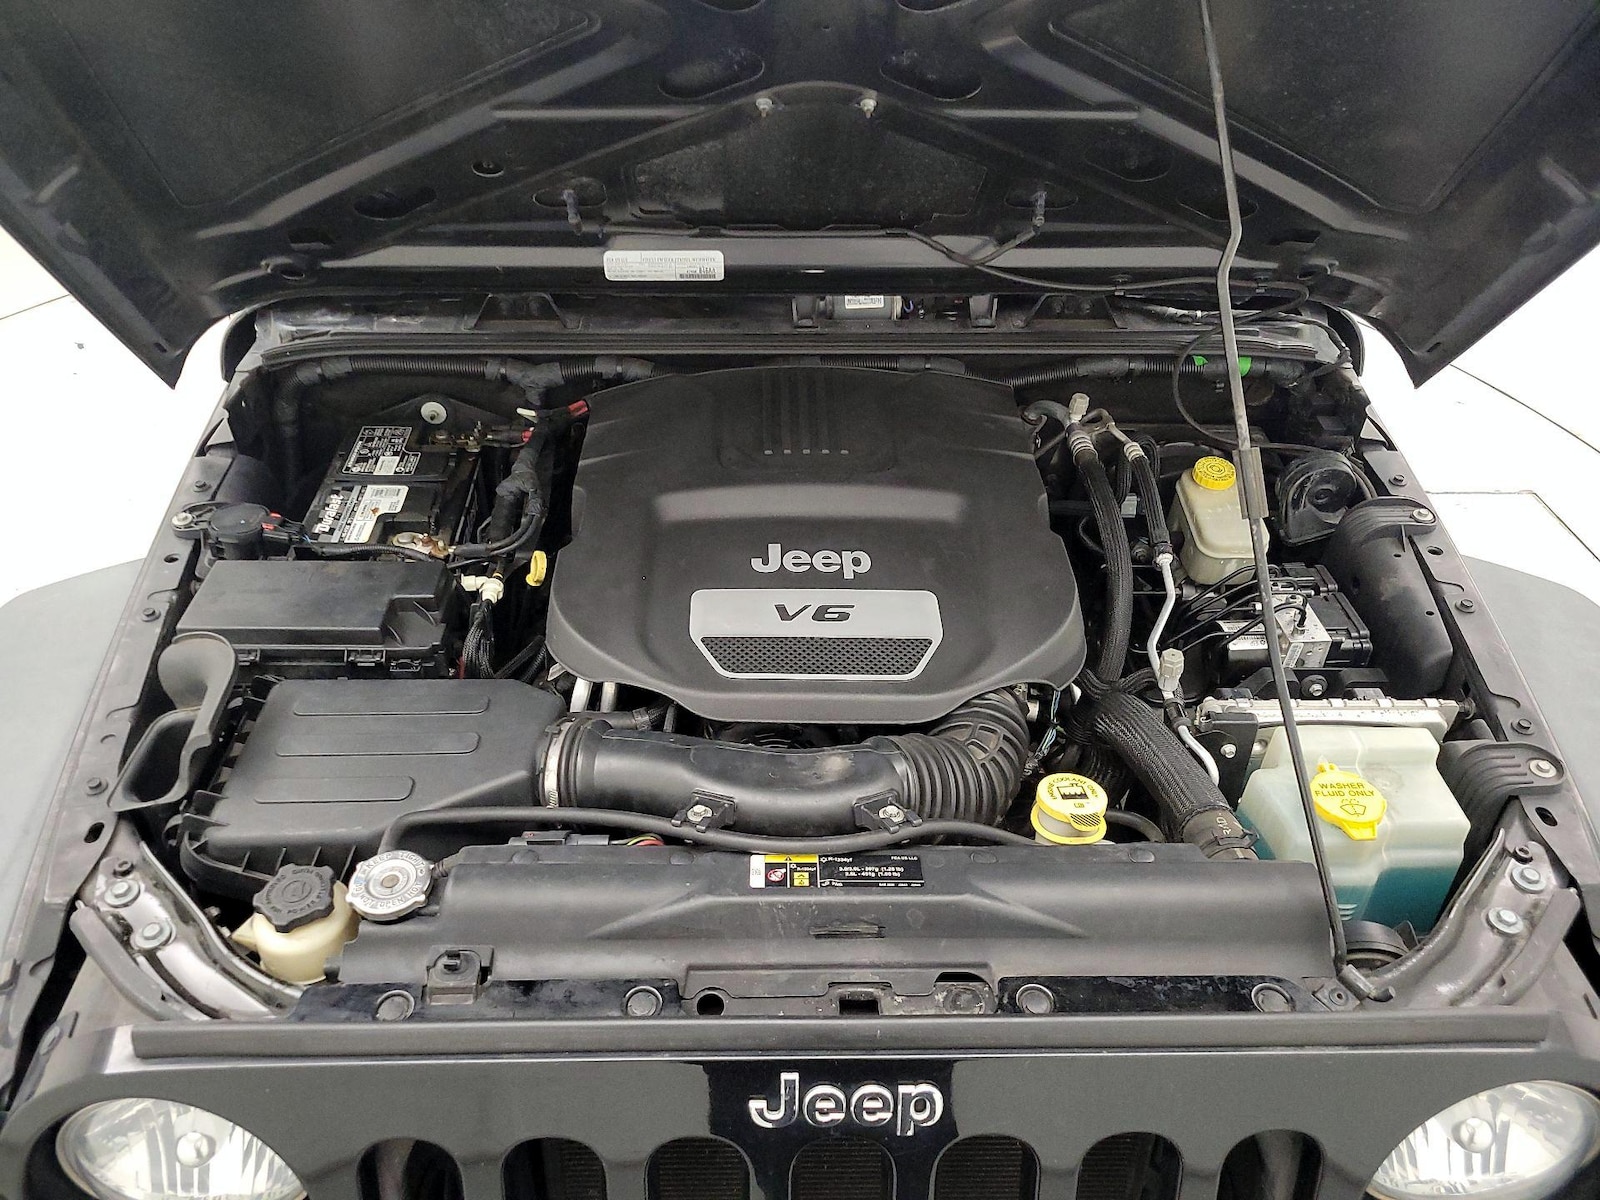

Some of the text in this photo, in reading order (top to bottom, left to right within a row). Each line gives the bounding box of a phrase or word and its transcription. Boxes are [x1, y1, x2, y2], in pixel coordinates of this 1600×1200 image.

[314, 493, 344, 534] Duralast
[751, 543, 872, 580] Jeep
[774, 604, 856, 622] V6
[1318, 782, 1365, 790] WASHER
[366, 851, 425, 870] KEEP TIGHT
[379, 897, 405, 908] OPEN
[407, 882, 422, 898] HOT
[748, 1071, 944, 1137] Jeep
